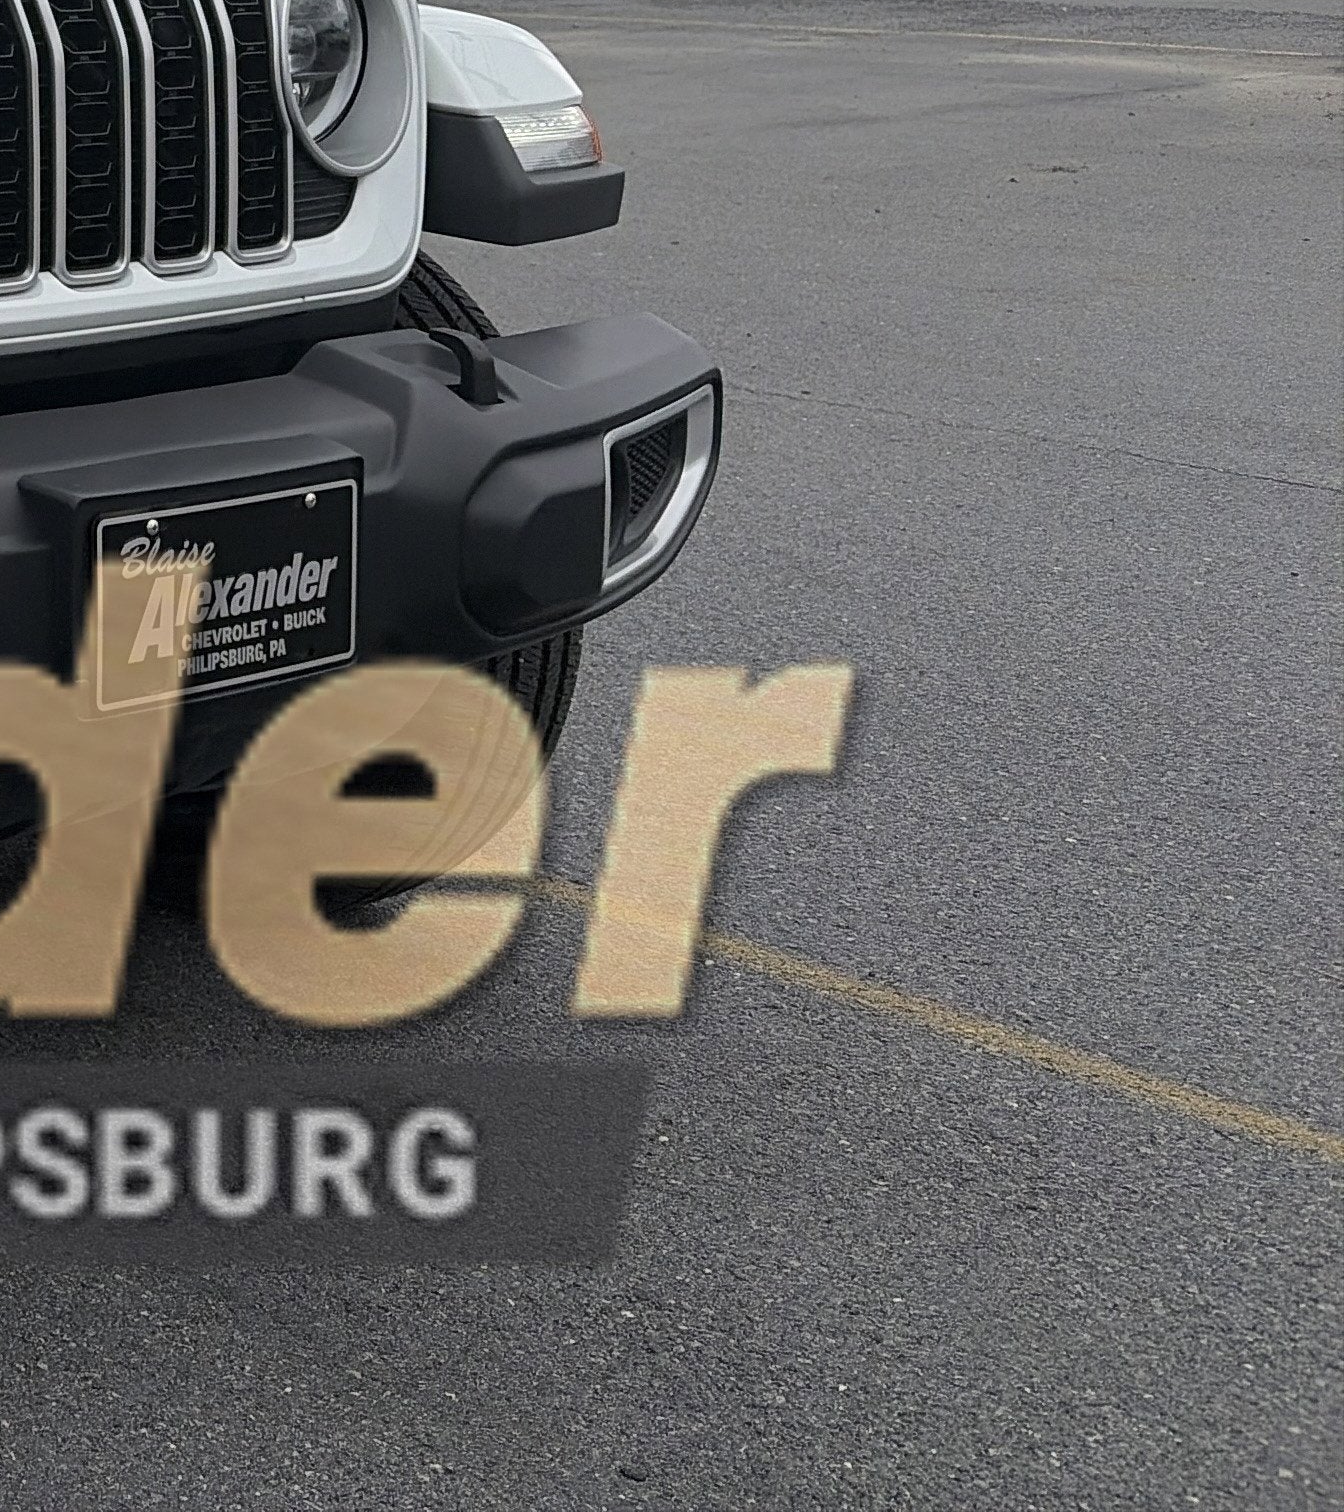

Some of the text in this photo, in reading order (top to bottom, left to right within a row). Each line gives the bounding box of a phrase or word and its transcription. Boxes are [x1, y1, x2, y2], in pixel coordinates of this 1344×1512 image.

[120, 536, 217, 580] Blaise
[127, 551, 339, 665] Alexander
[180, 606, 326, 653] CHEVROLET BUICK
[177, 637, 287, 678] PHILIPSBURG, PA
